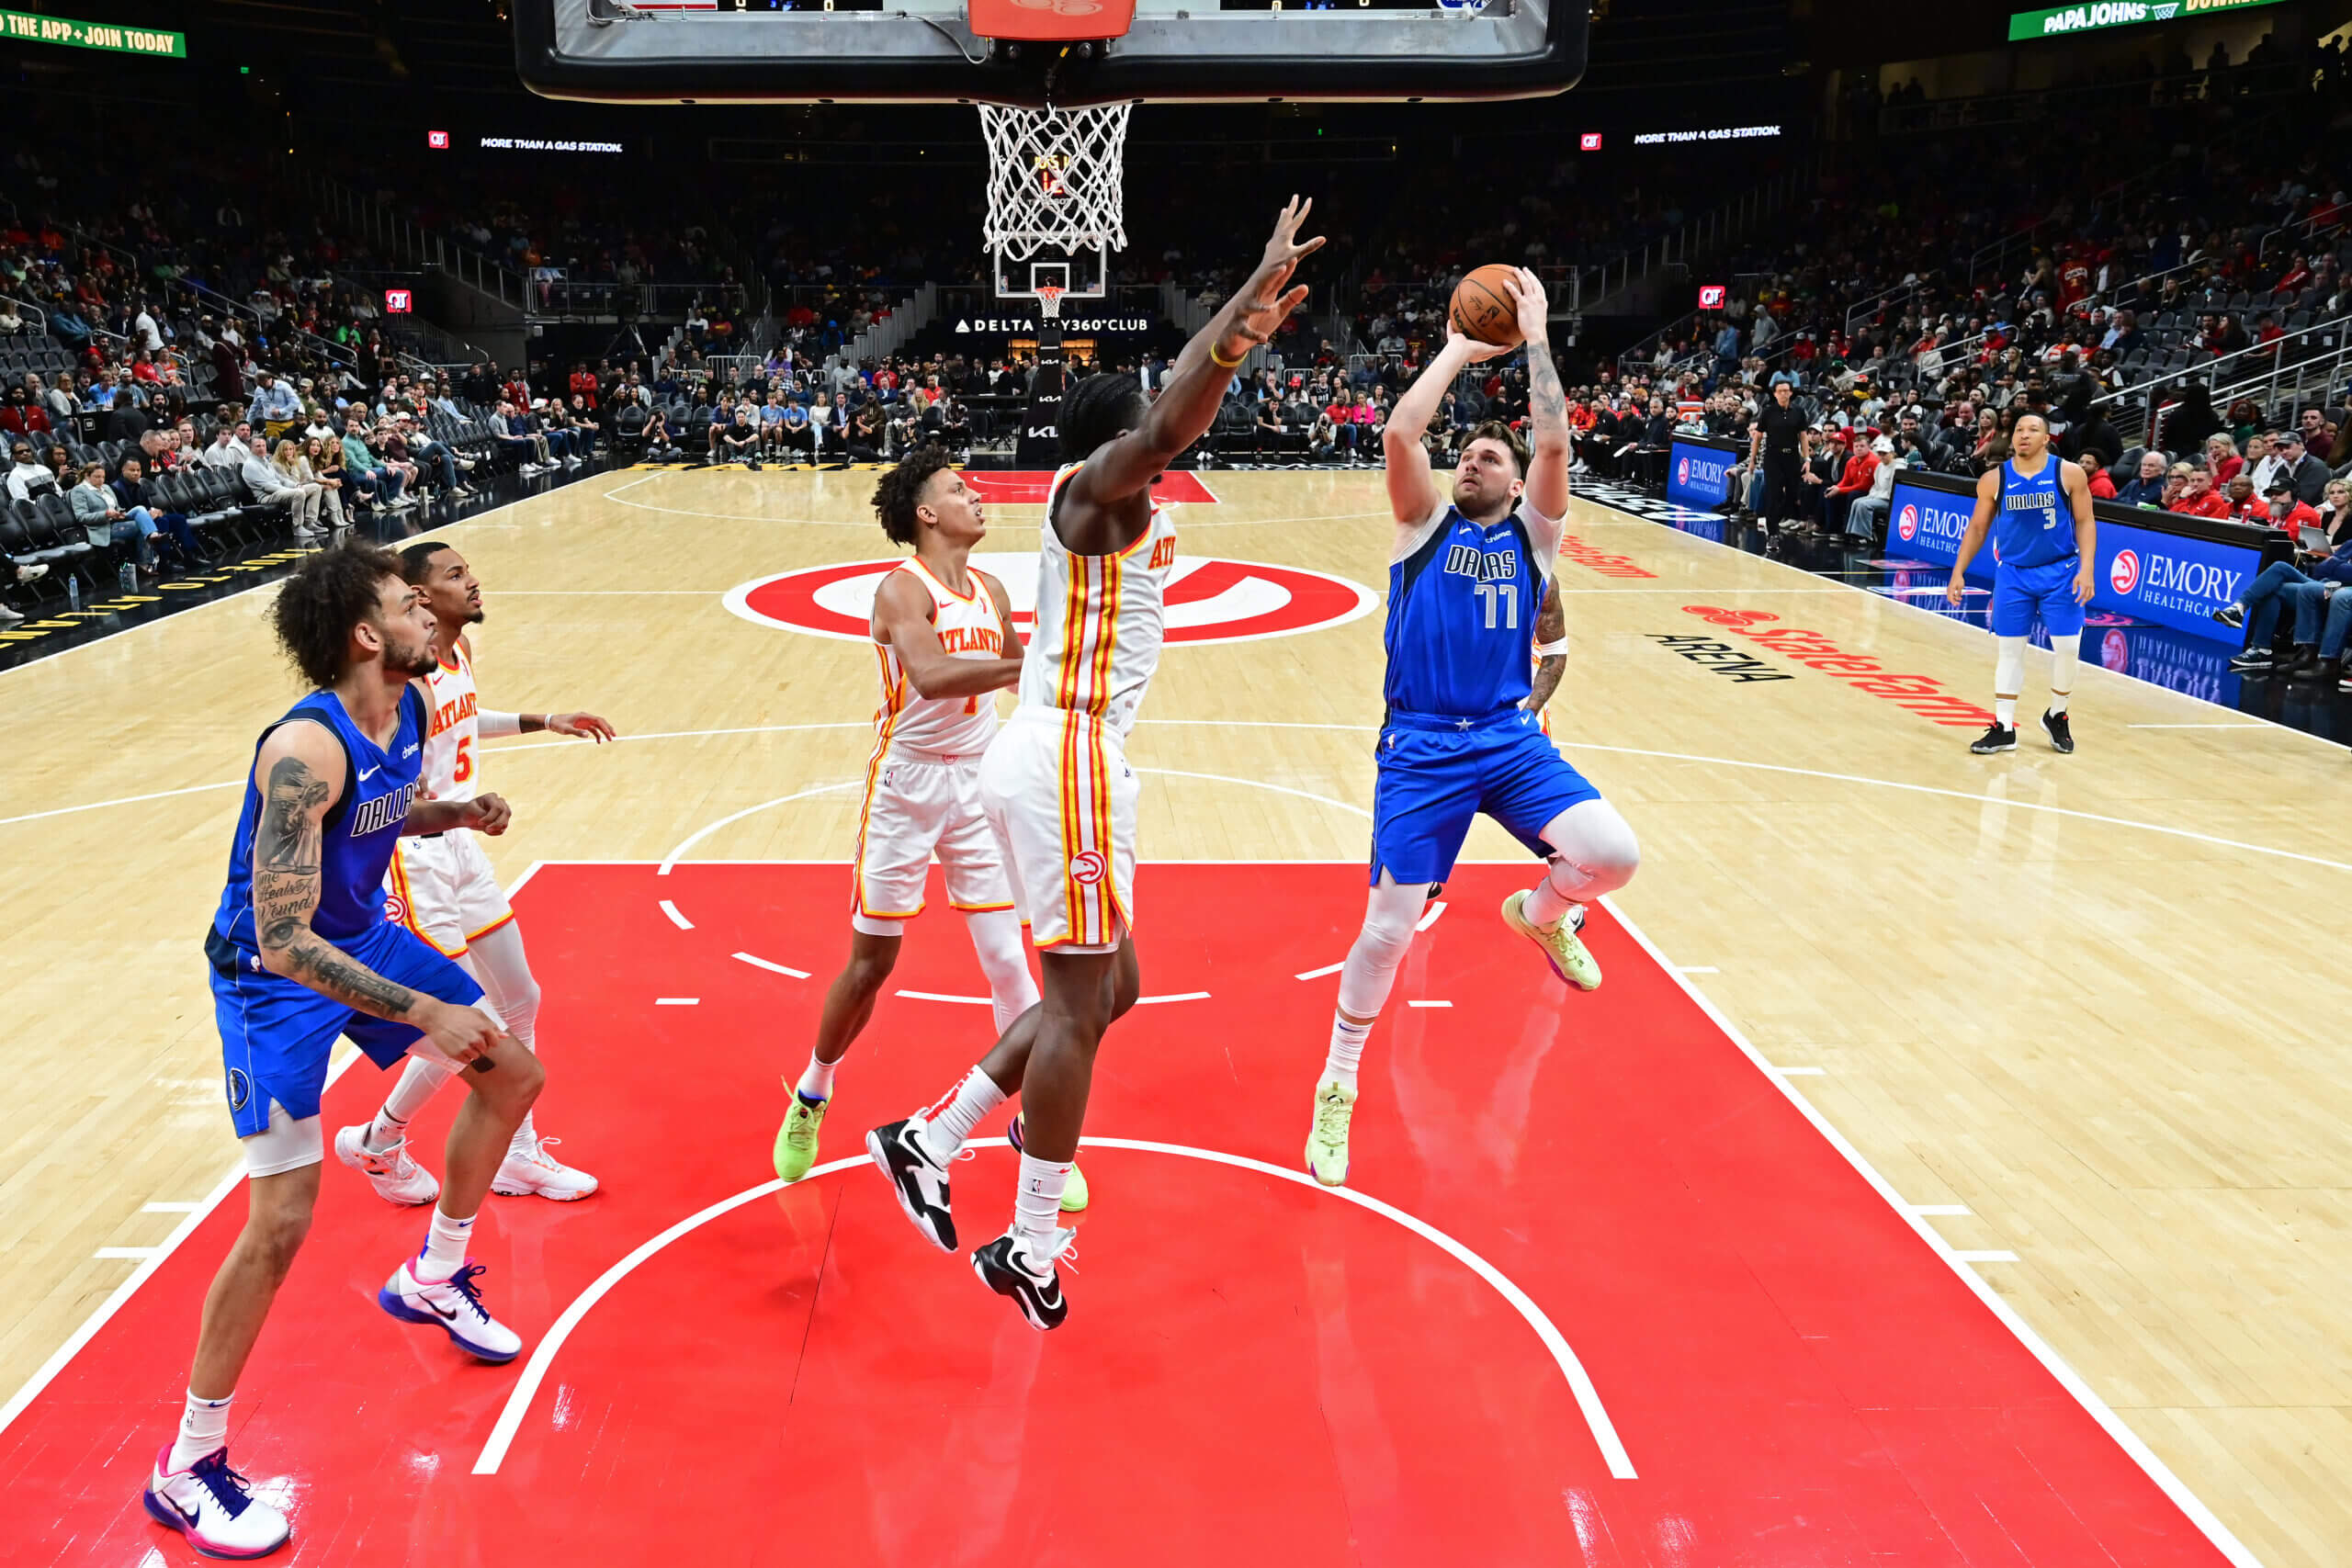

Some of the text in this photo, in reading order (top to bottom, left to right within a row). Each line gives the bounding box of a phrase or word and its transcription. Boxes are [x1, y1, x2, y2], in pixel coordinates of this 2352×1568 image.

[2043, 2, 2146, 33] PAPA JOHNS
[7, 15, 39, 37] THE
[41, 20, 73, 41] APP
[84, 27, 122, 48] JOIN
[125, 30, 175, 52] TODAY
[431, 133, 446, 146] QT
[481, 138, 623, 152] MORE THAN A GAS STATION.
[1583, 135, 1598, 147] QT
[1634, 126, 1781, 144] MORE THAN A GAS STATION.
[388, 293, 408, 310] QT
[1702, 288, 1722, 305] QT
[975, 319, 1035, 332] DELTA
[1108, 319, 1148, 331] CLUB
[1028, 426, 1059, 438] KI
[1691, 458, 1724, 484] EMORY
[2006, 491, 2055, 511] DALLAS
[1922, 507, 1970, 540] EMOR
[2042, 508, 2056, 530] 3
[1920, 536, 1960, 555] HEALTHC
[2147, 555, 2242, 603] EMORY
[1474, 583, 1518, 629] 77
[2144, 590, 2217, 617] HEALTHCA
[1644, 634, 1795, 683] ARENA
[429, 692, 479, 738] ATLANT
[454, 735, 473, 783] 5
[350, 776, 420, 838] DALLA
